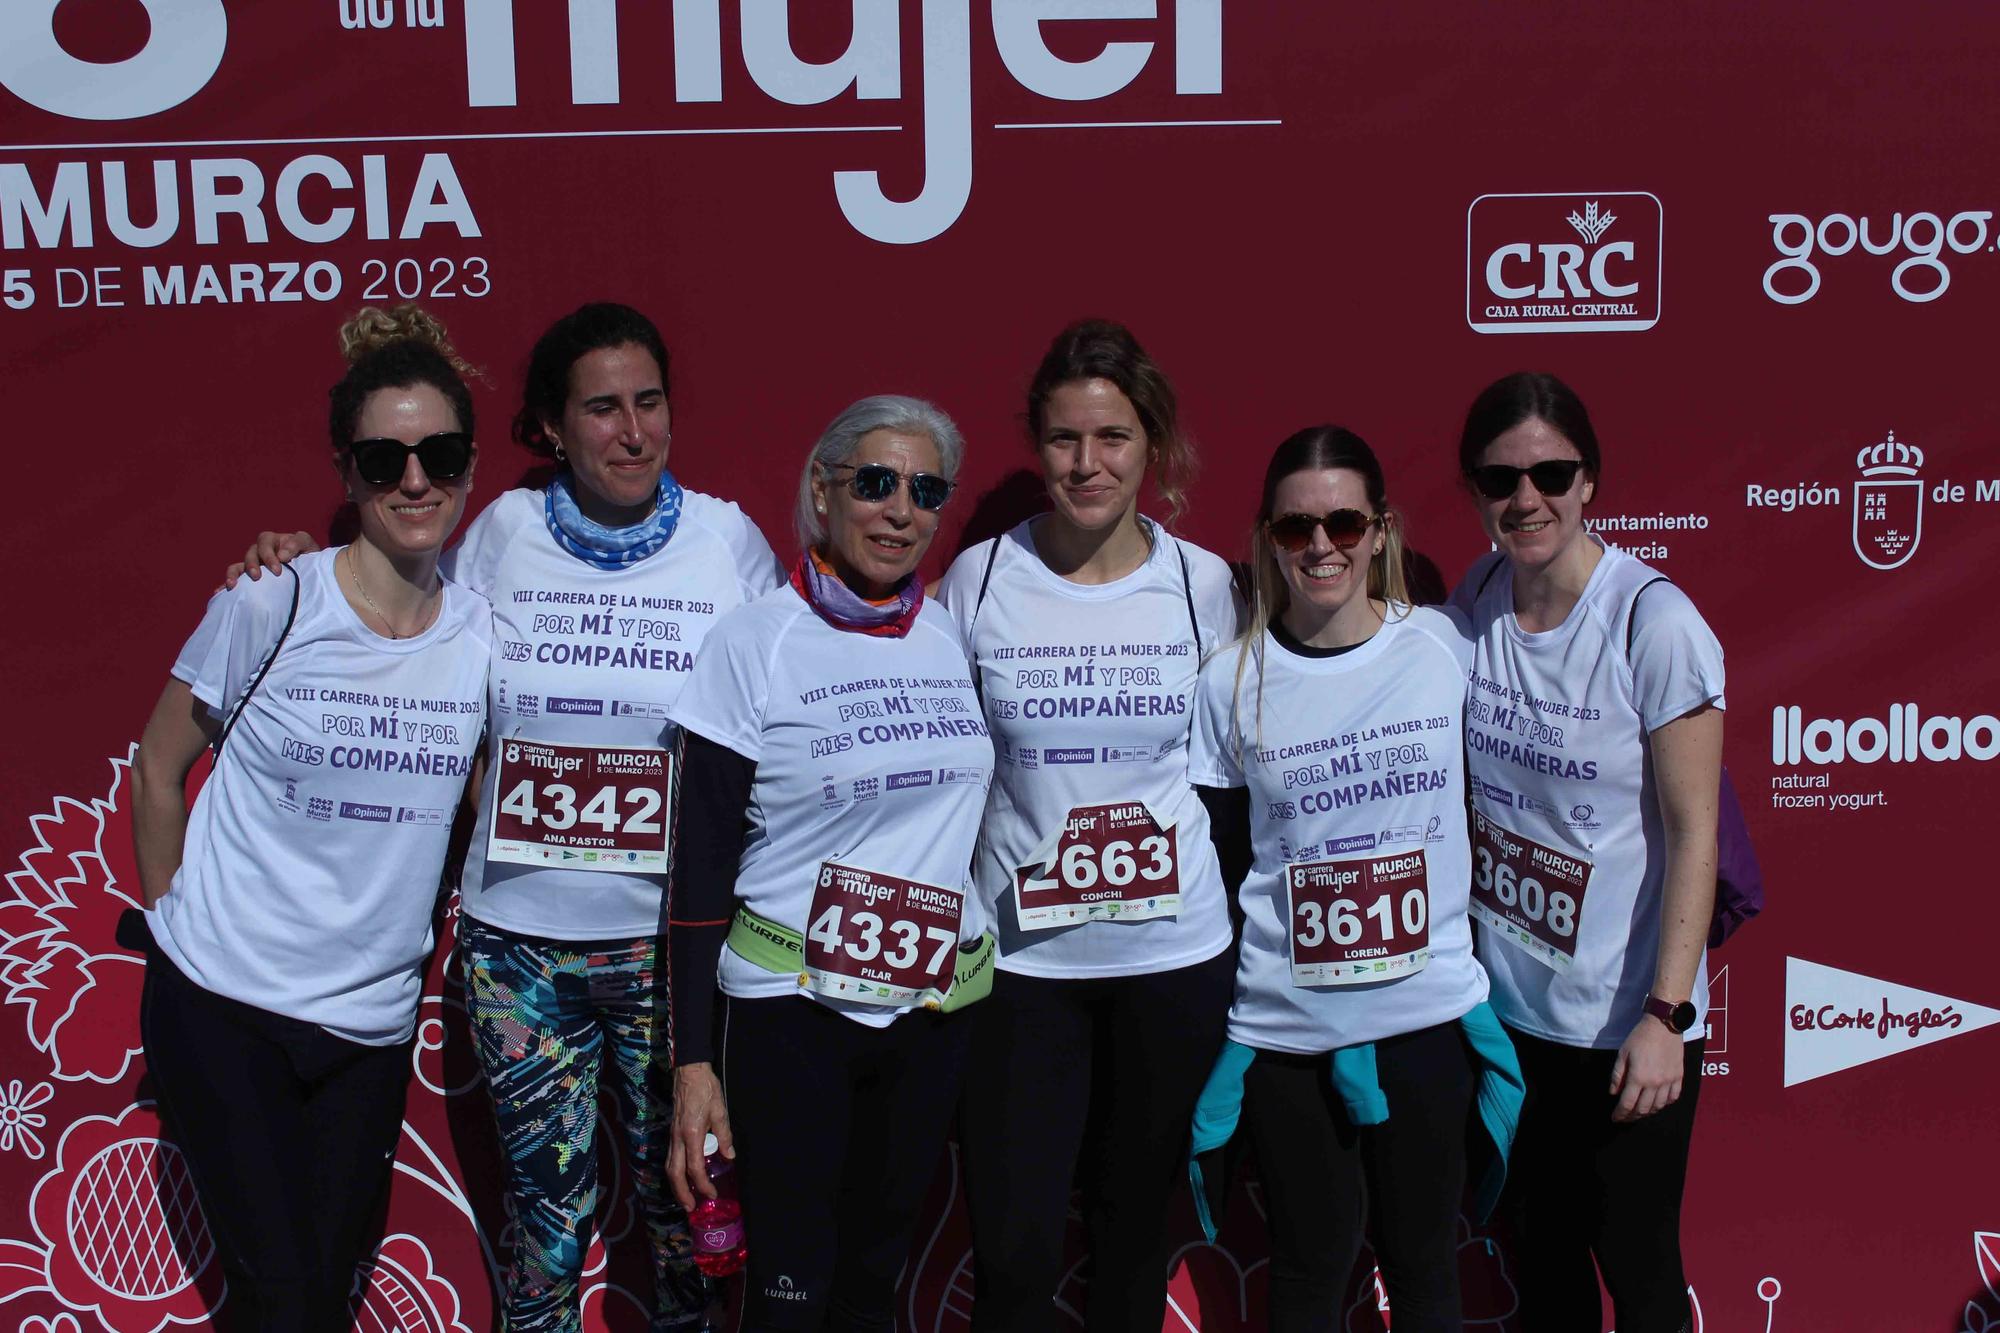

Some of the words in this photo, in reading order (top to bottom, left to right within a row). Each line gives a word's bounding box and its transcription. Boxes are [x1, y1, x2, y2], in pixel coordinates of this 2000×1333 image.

[0, 153, 482, 249] MURCIA
[1486, 242, 1638, 299] CRC
[1763, 211, 2000, 304] gougo.
[2, 270, 35, 309] 5
[56, 267, 125, 308] DE
[143, 261, 342, 305] MARZO
[361, 257, 491, 299] 2023
[1486, 306, 1519, 317] CAJA
[1523, 305, 1569, 316] RURAL
[1572, 304, 1637, 315] CENTRAL
[1746, 482, 1841, 513] Región
[1932, 480, 1965, 503] de
[1584, 512, 1708, 534] yuntamiento
[1611, 541, 1668, 559] urcia
[513, 591, 533, 602] VIII
[537, 591, 595, 605] CARRERA
[600, 595, 616, 606] DE
[622, 595, 637, 608] LA
[642, 598, 683, 611] MUJER
[688, 601, 714, 614] 2023
[533, 614, 574, 634] POR
[581, 608, 613, 634] MÍ
[619, 618, 634, 637] Y
[638, 619, 681, 641] POR
[502, 641, 532, 662] MIS
[536, 642, 693, 672] COMPAÑERA
[993, 648, 1015, 659] VIII
[1018, 646, 1075, 658] CARRERA
[1080, 646, 1096, 657] DE
[1101, 646, 1116, 656] LA
[1121, 645, 1162, 656] MUJER
[1166, 645, 1188, 656] 2023
[1016, 670, 1058, 688] POR
[1064, 659, 1094, 686] MÍ
[1100, 668, 1115, 686] Y
[1120, 667, 1161, 685] POR
[286, 689, 315, 700] VIII
[320, 689, 379, 707] CARRERA
[384, 697, 399, 708] DE
[403, 699, 416, 710] LA
[422, 700, 457, 713] MUJER
[460, 702, 479, 713] 2023
[800, 688, 828, 705] VIII
[831, 679, 886, 695] CARRERA
[890, 679, 905, 689] DE
[907, 679, 919, 688] LA
[922, 679, 953, 689] MUJER
[992, 698, 1017, 718] MIS
[1023, 690, 1185, 718] COMPAÑERAS
[1511, 690, 1522, 702] DE
[1535, 699, 1569, 716] MUJER
[1572, 707, 1600, 720] 2023
[839, 701, 884, 722] POR
[883, 690, 913, 715] MÍ
[913, 698, 928, 714] Y
[931, 697, 970, 713] POR
[322, 714, 365, 737] POR
[371, 711, 398, 739] MÍ
[403, 723, 416, 741] Y
[421, 724, 459, 744] POR
[1468, 696, 1489, 724] POR
[1492, 704, 1516, 731] MÍ
[1518, 716, 1530, 736] Y
[1530, 721, 1563, 747] POR
[1772, 703, 2000, 765] llaollao
[282, 737, 324, 765] MIS
[523, 745, 554, 756] carrera
[811, 733, 853, 758] MIS
[1280, 737, 1338, 760] CARRERA
[1342, 733, 1358, 746] DE
[1362, 729, 1378, 741] LA
[1382, 720, 1423, 736] MUJER
[1426, 716, 1449, 730] 2023
[530, 754, 583, 778] mujer
[598, 753, 662, 767] MURCIA
[1284, 765, 1328, 789] POR
[1330, 746, 1363, 777] MÍ
[1366, 750, 1381, 770] Y
[1386, 743, 1428, 766] POR
[1468, 728, 1597, 780] COMPAÑERAS
[1300, 769, 1447, 814] COMPAÑERAS
[1772, 773, 1829, 788] natural
[501, 779, 662, 834] 4342
[1772, 793, 1824, 808] frozen
[1829, 791, 1888, 810] yogurt.
[543, 834, 566, 843] ANA
[570, 836, 614, 846] PASTOR
[1065, 817, 1097, 839] ujer
[1491, 830, 1523, 859] mujer
[837, 869, 871, 883] carrera
[1308, 865, 1334, 874] carrera
[1373, 856, 1422, 876] MURCIA
[1390, 872, 1410, 880] MARZO
[1412, 869, 1423, 877] 2023
[1533, 848, 1582, 878] MURCIA
[1545, 866, 1566, 879] MARZO
[843, 879, 896, 906] mujer
[1315, 869, 1359, 894] mujer
[1474, 846, 1576, 937] 3608
[908, 886, 958, 910] MURCIA
[1081, 891, 1122, 901] CONCHI
[921, 905, 944, 915] MARZO
[1296, 889, 1426, 947] 3610
[1506, 910, 1531, 930] LAURA
[742, 915, 803, 953] LURBE
[808, 905, 957, 976] 4337
[1345, 947, 1388, 959] LORENA
[861, 967, 891, 982] PILAR
[1790, 1004, 1815, 1031] El
[1817, 1005, 1875, 1030] Corte
[1878, 997, 1962, 1039] Inglés
[765, 1288, 808, 1300] LURBEL
